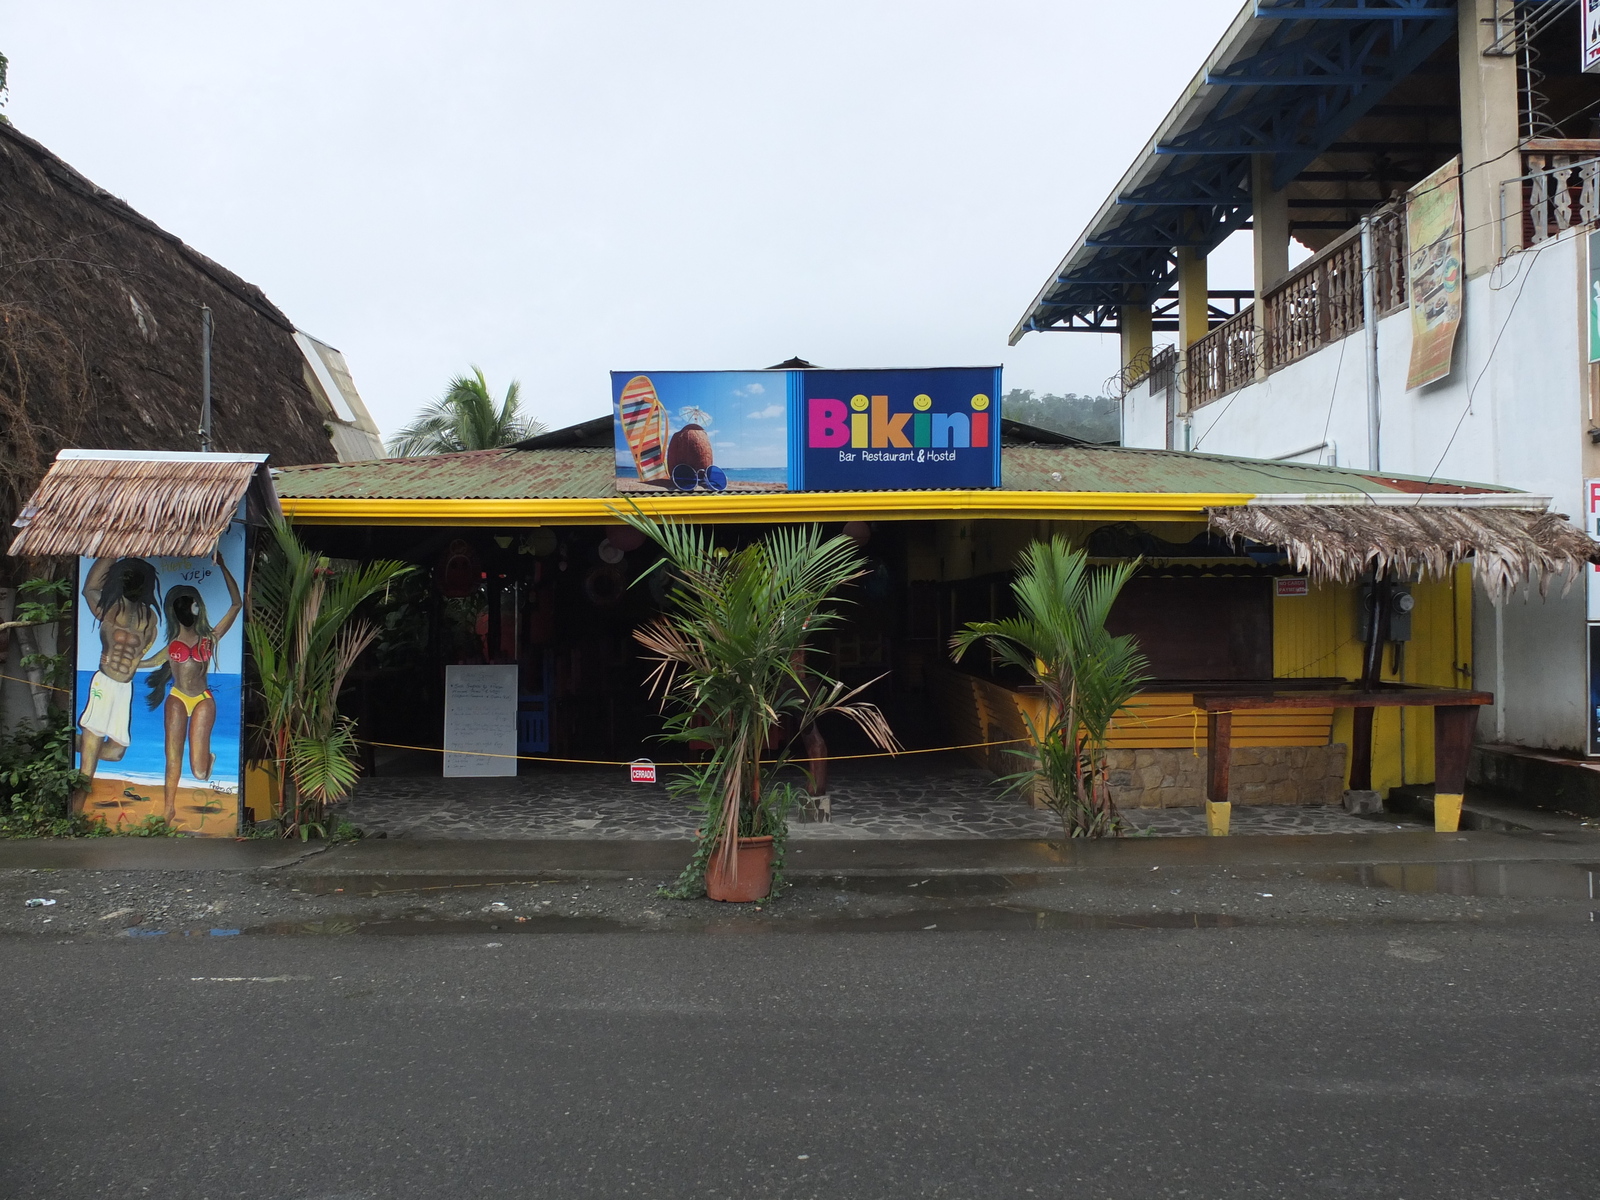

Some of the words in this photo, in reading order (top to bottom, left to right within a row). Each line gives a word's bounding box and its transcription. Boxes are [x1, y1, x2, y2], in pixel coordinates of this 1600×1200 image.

[808, 393, 990, 449] Bikini
[839, 450, 856, 462] Bar
[862, 450, 915, 462] Restaurant
[916, 449, 925, 463] &
[927, 450, 956, 462] Hostel
[632, 770, 654, 779] CERRADO
